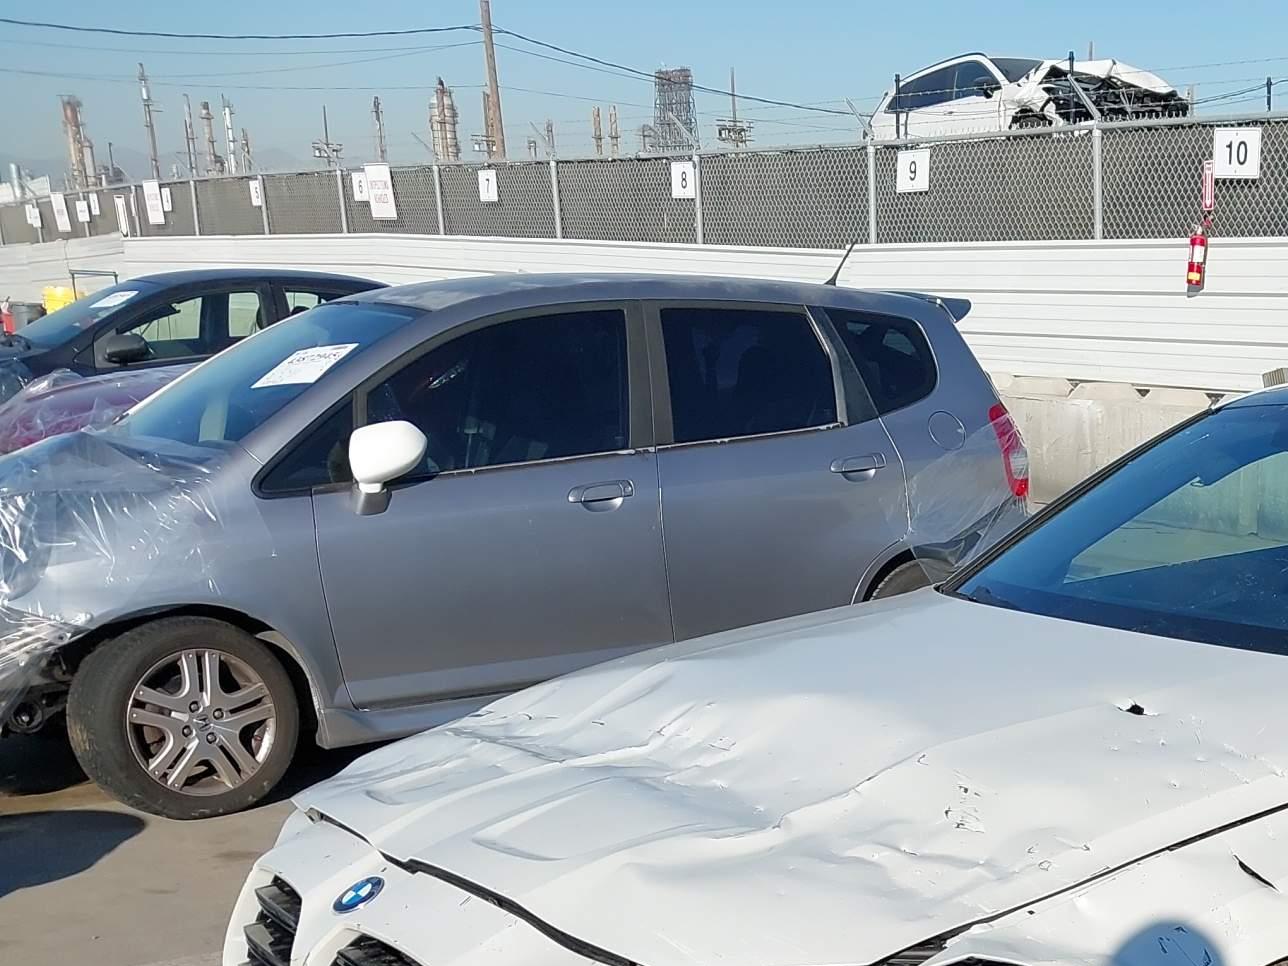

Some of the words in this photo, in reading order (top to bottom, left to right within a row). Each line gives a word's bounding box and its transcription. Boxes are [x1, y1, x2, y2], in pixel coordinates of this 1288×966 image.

[1225, 140, 1248, 166] 10
[680, 170, 688, 190] 8
[908, 160, 918, 182] 9
[254, 186, 260, 199] 5
[358, 179, 364, 194] 6
[485, 178, 491, 194] 7
